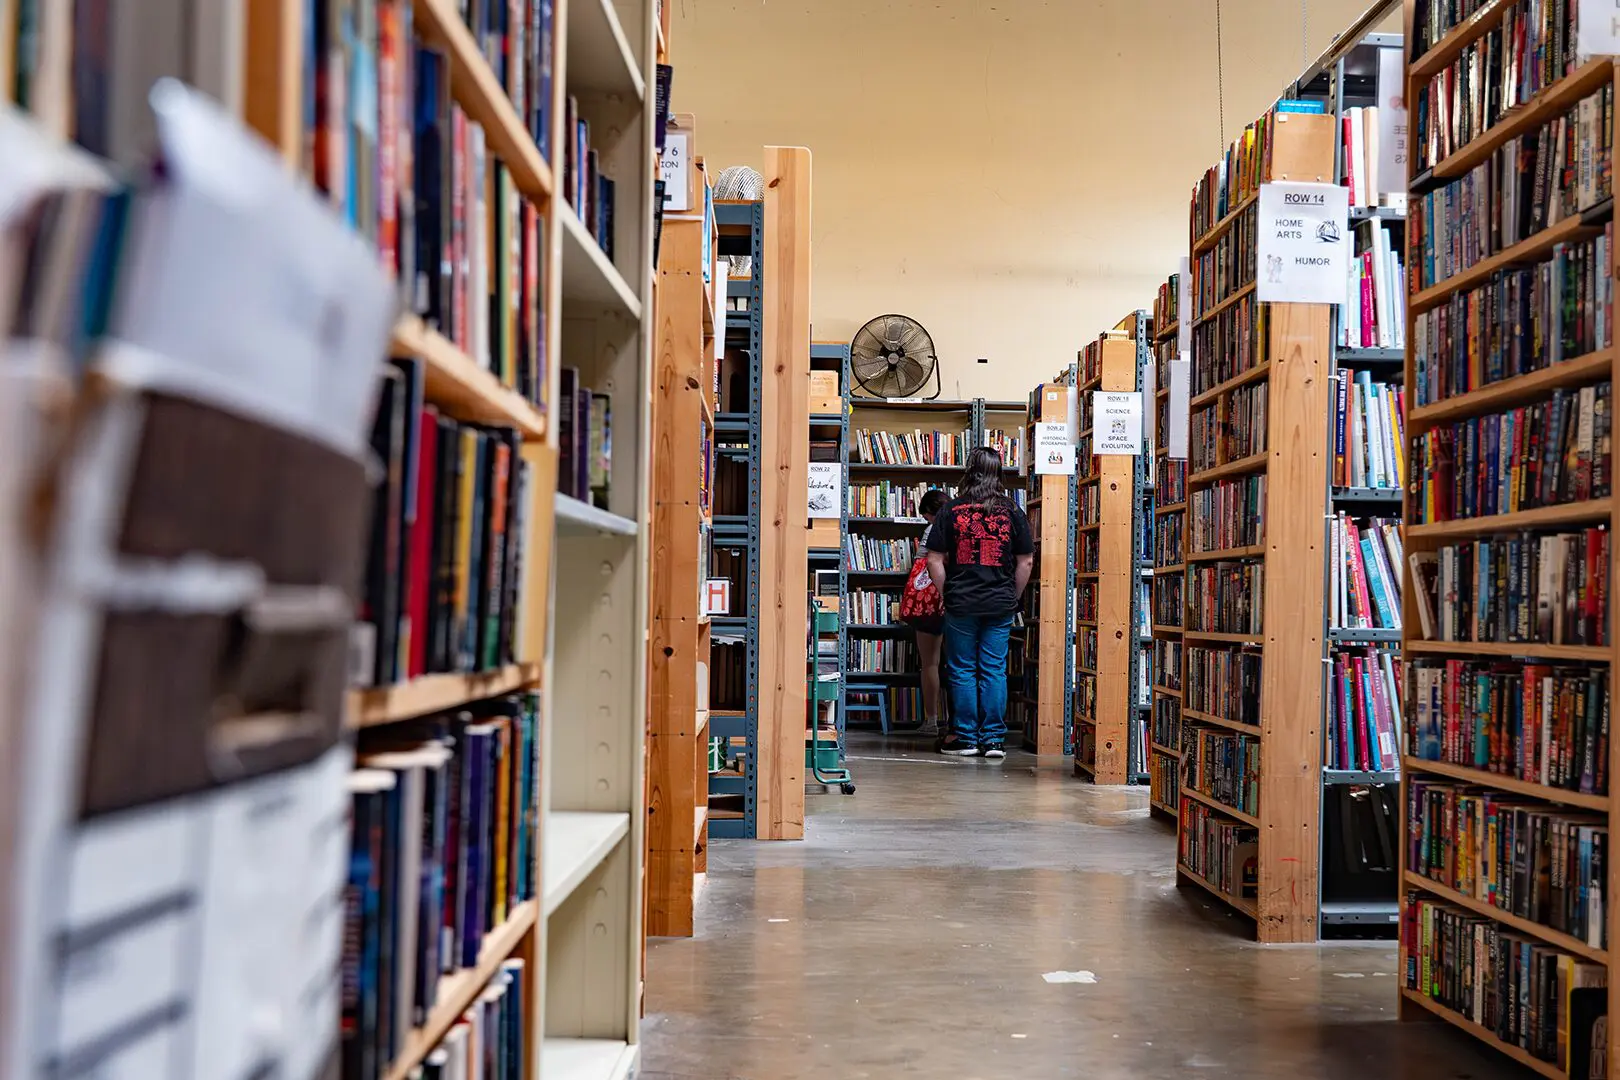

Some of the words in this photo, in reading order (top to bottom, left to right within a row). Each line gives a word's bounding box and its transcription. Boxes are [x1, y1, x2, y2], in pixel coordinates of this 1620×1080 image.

[672, 147, 678, 156] 6
[1284, 193, 1310, 203] ROW
[1313, 194, 1325, 203] 14
[1275, 219, 1304, 227] HOME
[1276, 231, 1303, 239] ARTS
[1295, 257, 1331, 266] HUMOR
[708, 583, 726, 611] H
